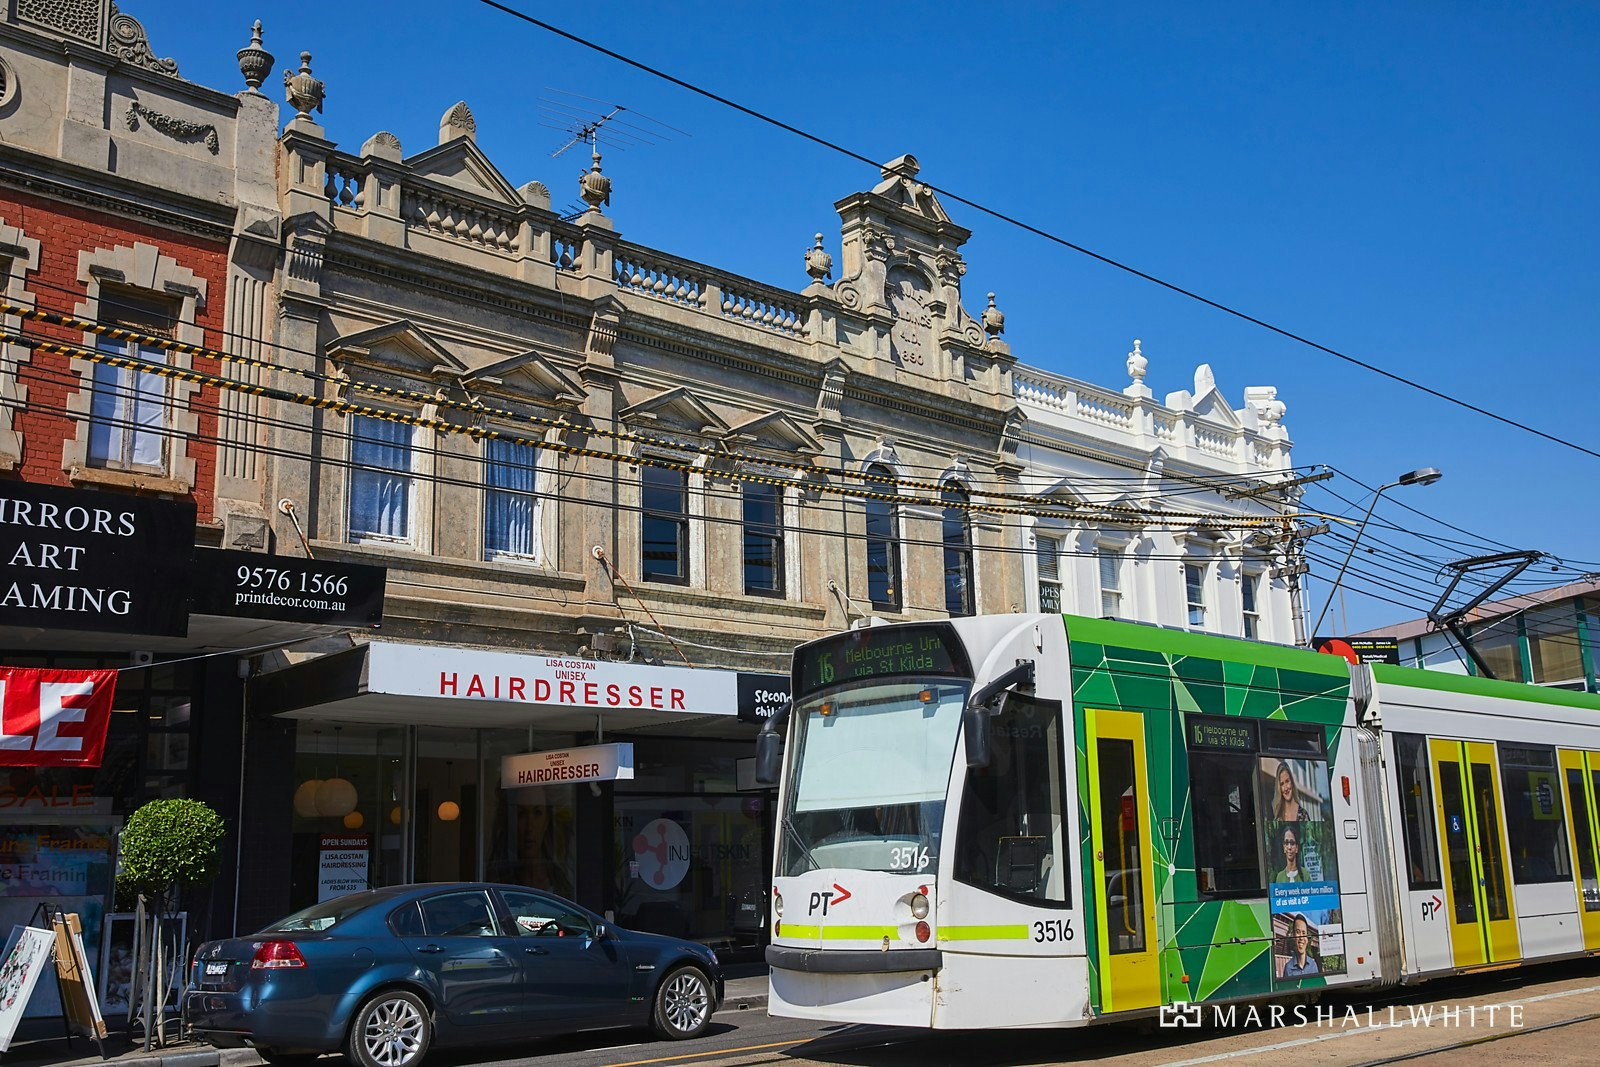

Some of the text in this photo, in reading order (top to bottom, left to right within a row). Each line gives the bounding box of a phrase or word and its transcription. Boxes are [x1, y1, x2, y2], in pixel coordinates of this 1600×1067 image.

[898, 349, 924, 366] 890
[8, 541, 86, 571] ART
[236, 565, 349, 596] 9576 1566
[0, 581, 132, 615] AMING
[235, 590, 346, 611] printdecor.com.au
[846, 637, 941, 663] Melbourne Uni
[545, 658, 596, 671] LISA COSTAN
[818, 652, 834, 684] 16
[855, 654, 933, 677] via St Kilda
[555, 669, 586, 681] UNISEX
[440, 671, 686, 710] HAIRDRESSER
[755, 705, 781, 718] chil
[1194, 725, 1203, 744] 16
[1220, 735, 1228, 746] St
[1230, 736, 1245, 747] Kilda
[554, 752, 570, 760] COSTAN
[518, 763, 600, 784] HAIRDRESSER
[0, 784, 95, 808] SALE
[322, 838, 368, 846] OPEN SUNDAYS
[669, 844, 750, 862] INJSKIN
[890, 846, 930, 869] 3516
[321, 861, 367, 869] HAIRDRESSING
[1275, 888, 1287, 897] Every
[1288, 887, 1300, 895] week
[1311, 886, 1319, 894] two
[1320, 885, 1333, 894] million
[1288, 897, 1297, 905] visit
[1033, 919, 1074, 943] 3516
